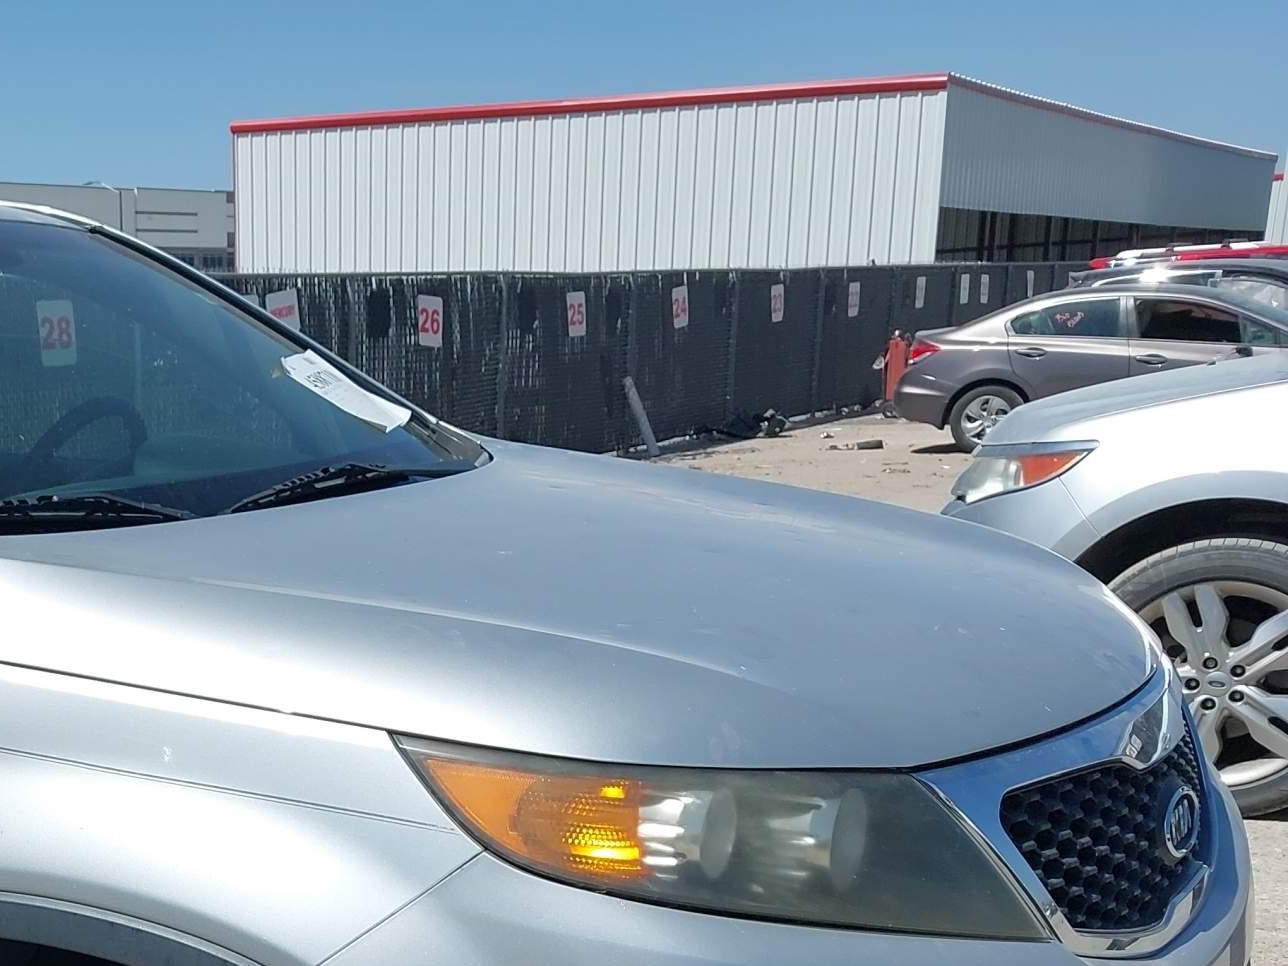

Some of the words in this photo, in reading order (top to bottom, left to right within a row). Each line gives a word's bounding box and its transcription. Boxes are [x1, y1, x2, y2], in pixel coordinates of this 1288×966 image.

[568, 303, 584, 326] 25
[674, 296, 687, 319] 24
[40, 315, 72, 350] 28
[420, 308, 440, 335] 26
